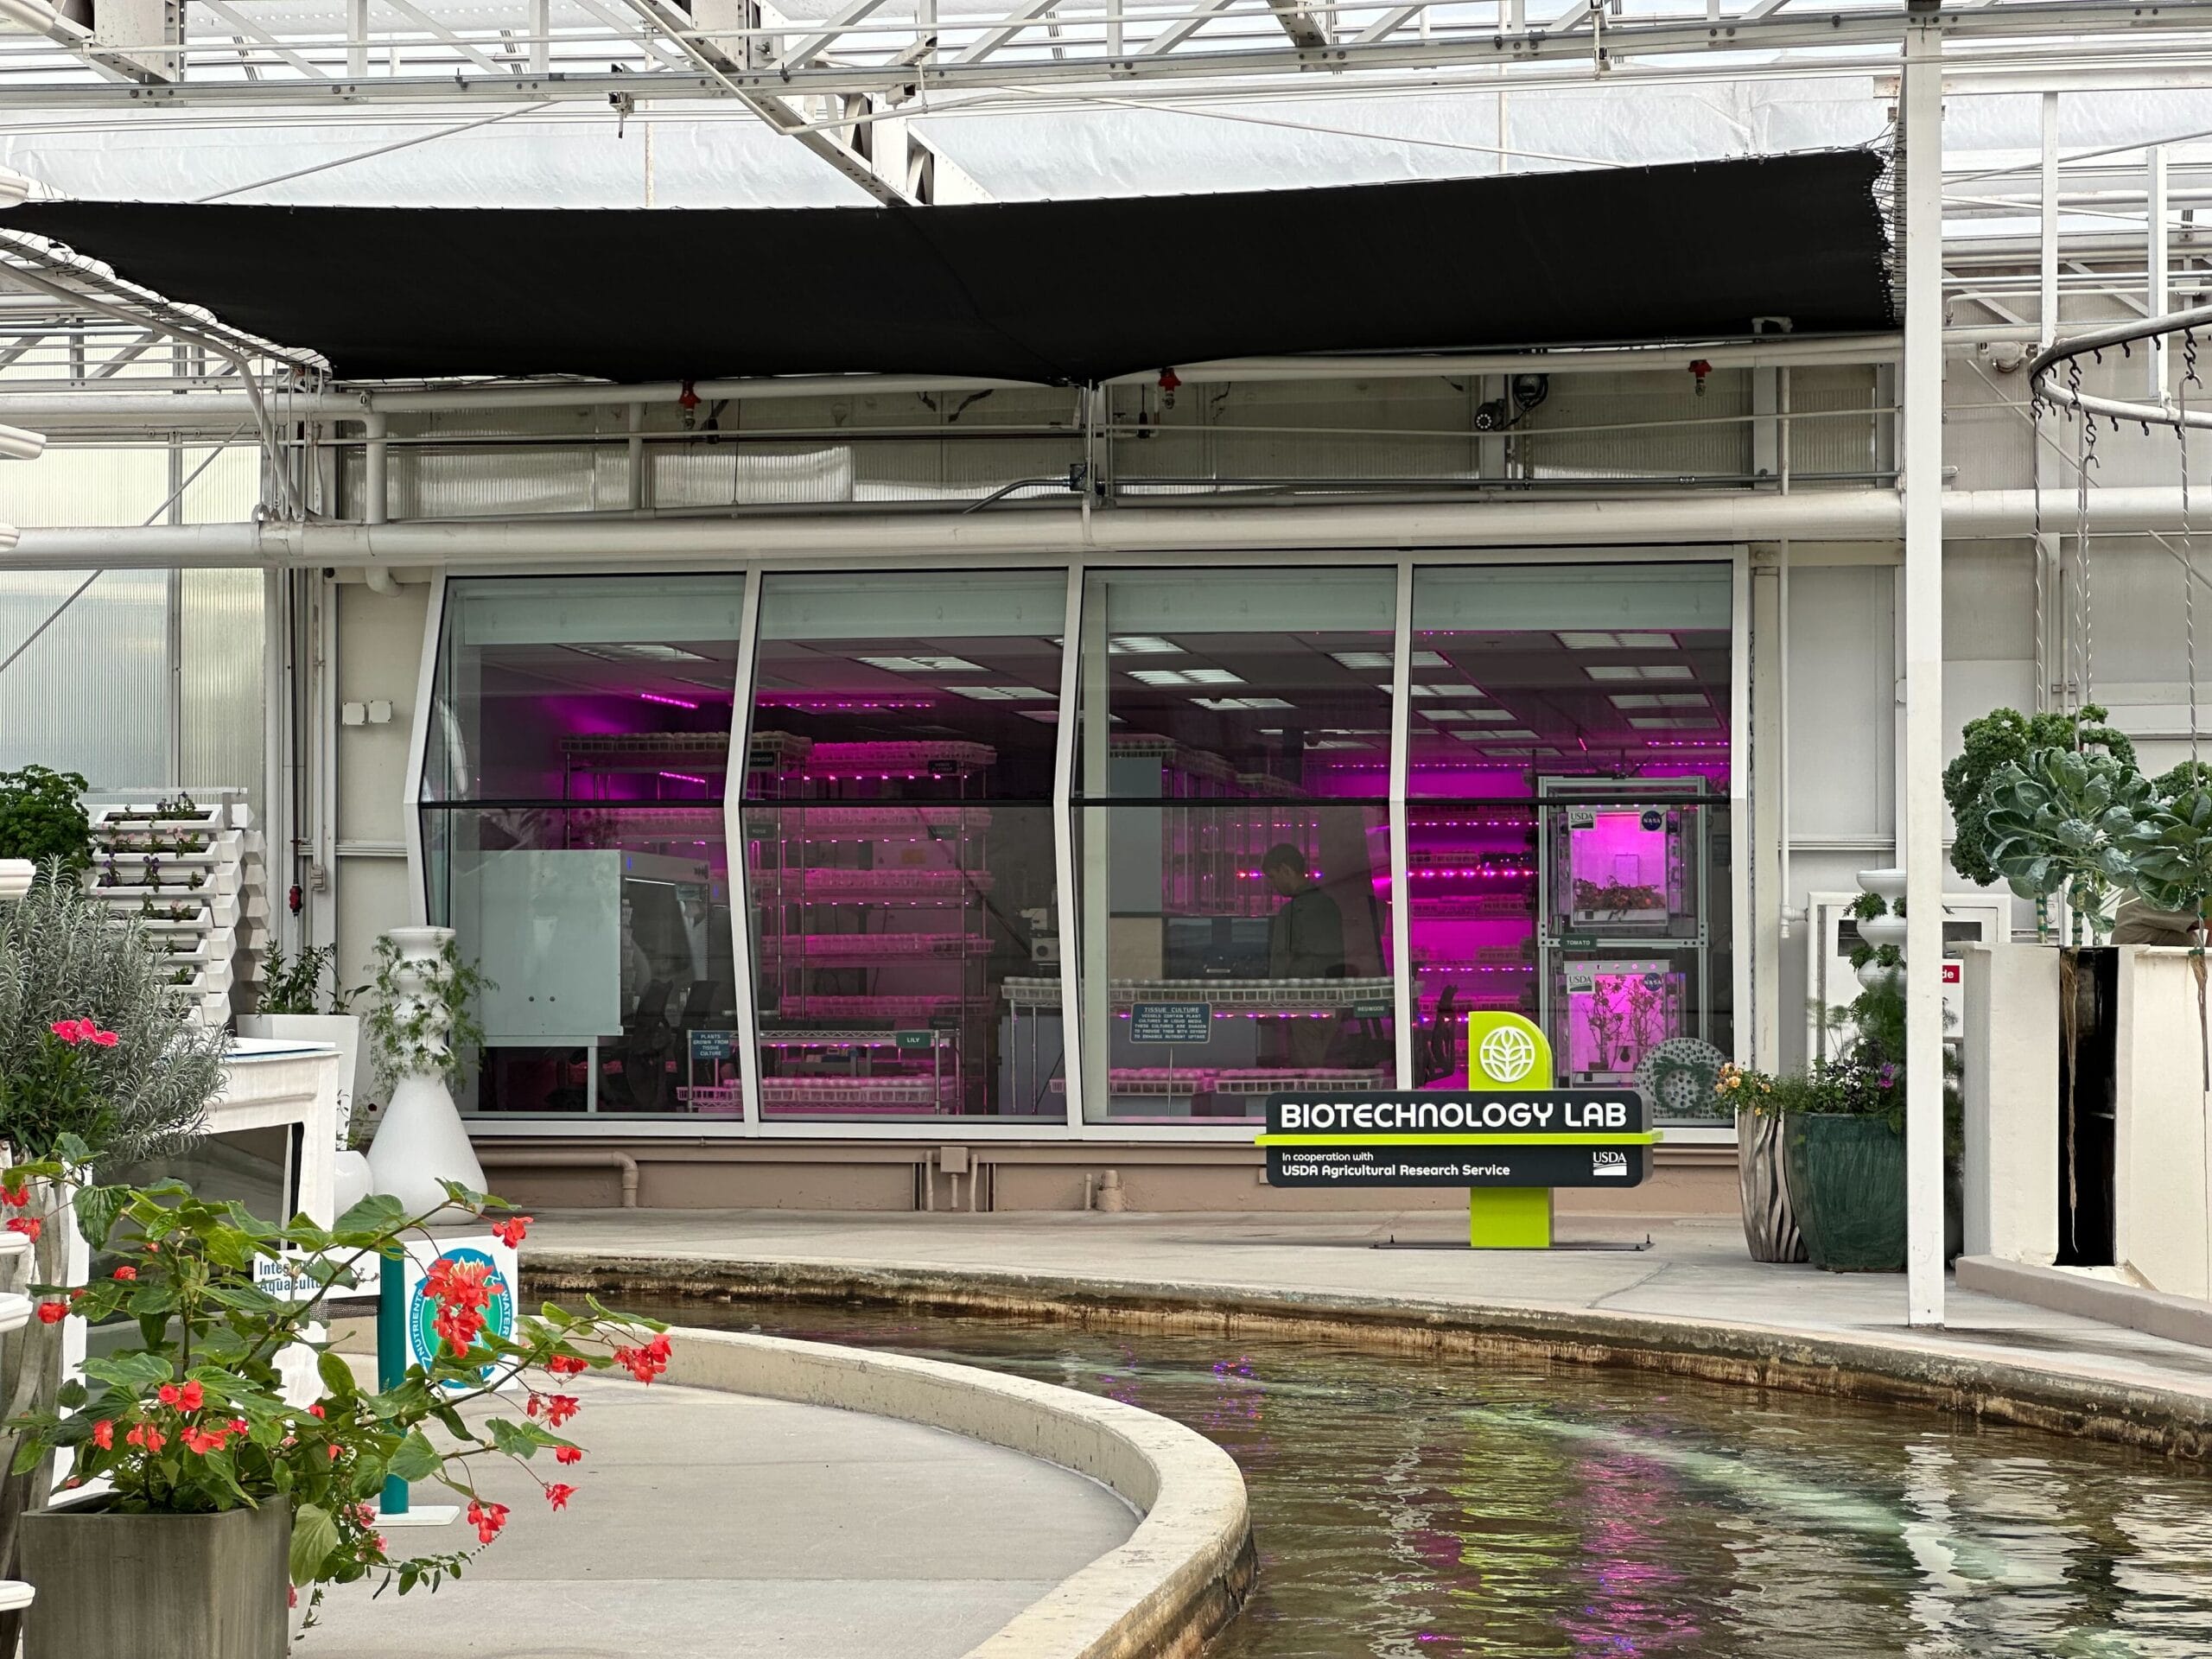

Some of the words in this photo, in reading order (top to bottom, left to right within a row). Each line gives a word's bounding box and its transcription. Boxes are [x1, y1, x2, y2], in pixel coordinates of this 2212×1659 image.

[1281, 1103, 1554, 1128] BIOTECHNOLOGY
[1565, 1103, 1626, 1128] LAB
[1282, 1153, 1291, 1161] In
[1294, 1152, 1351, 1162] cooperation
[1353, 1152, 1374, 1161] with
[1593, 1151, 1627, 1163] USDA
[1282, 1165, 1319, 1176] USDA
[1322, 1164, 1395, 1179] Agricultural
[1400, 1164, 1459, 1176] Research
[1462, 1164, 1510, 1176] Service
[501, 1291, 512, 1336] WATER
